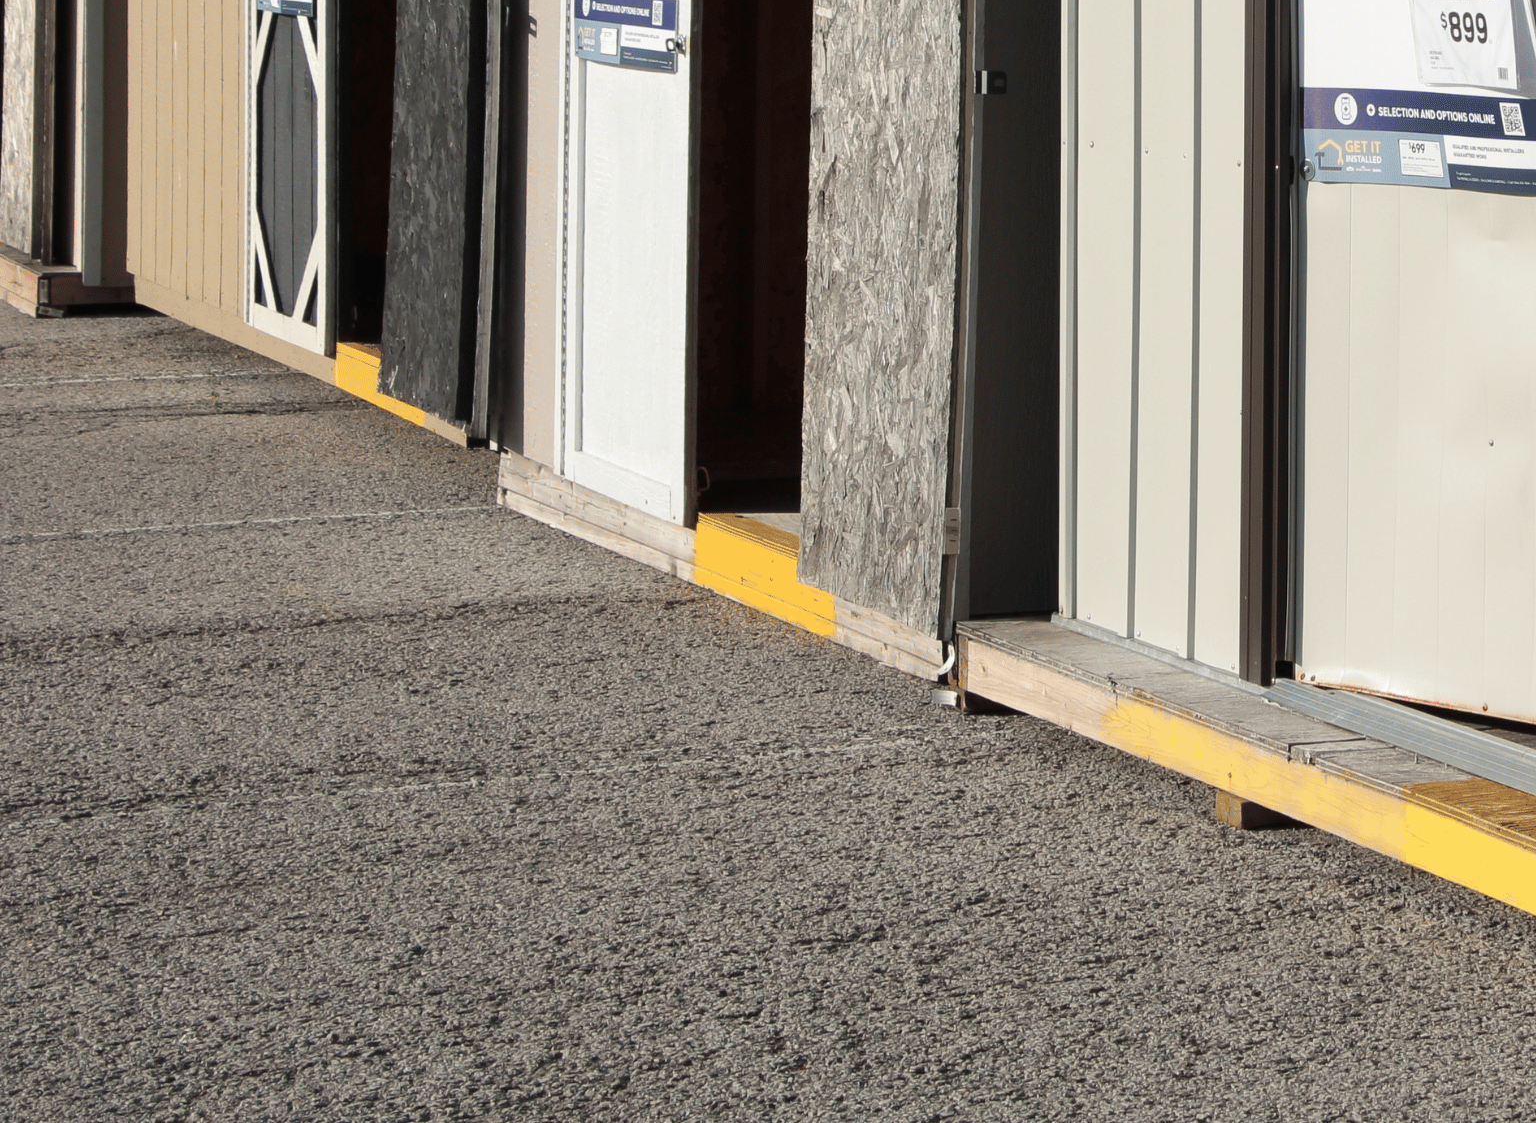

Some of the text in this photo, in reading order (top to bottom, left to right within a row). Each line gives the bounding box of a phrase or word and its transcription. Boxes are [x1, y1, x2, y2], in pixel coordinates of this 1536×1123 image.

[1440, 11, 1488, 44] $899
[1378, 107, 1495, 125] SELECTION AND OPTIONS ONLINE
[1345, 140, 1381, 153] GET IT
[1345, 155, 1382, 164] INSTALLED
